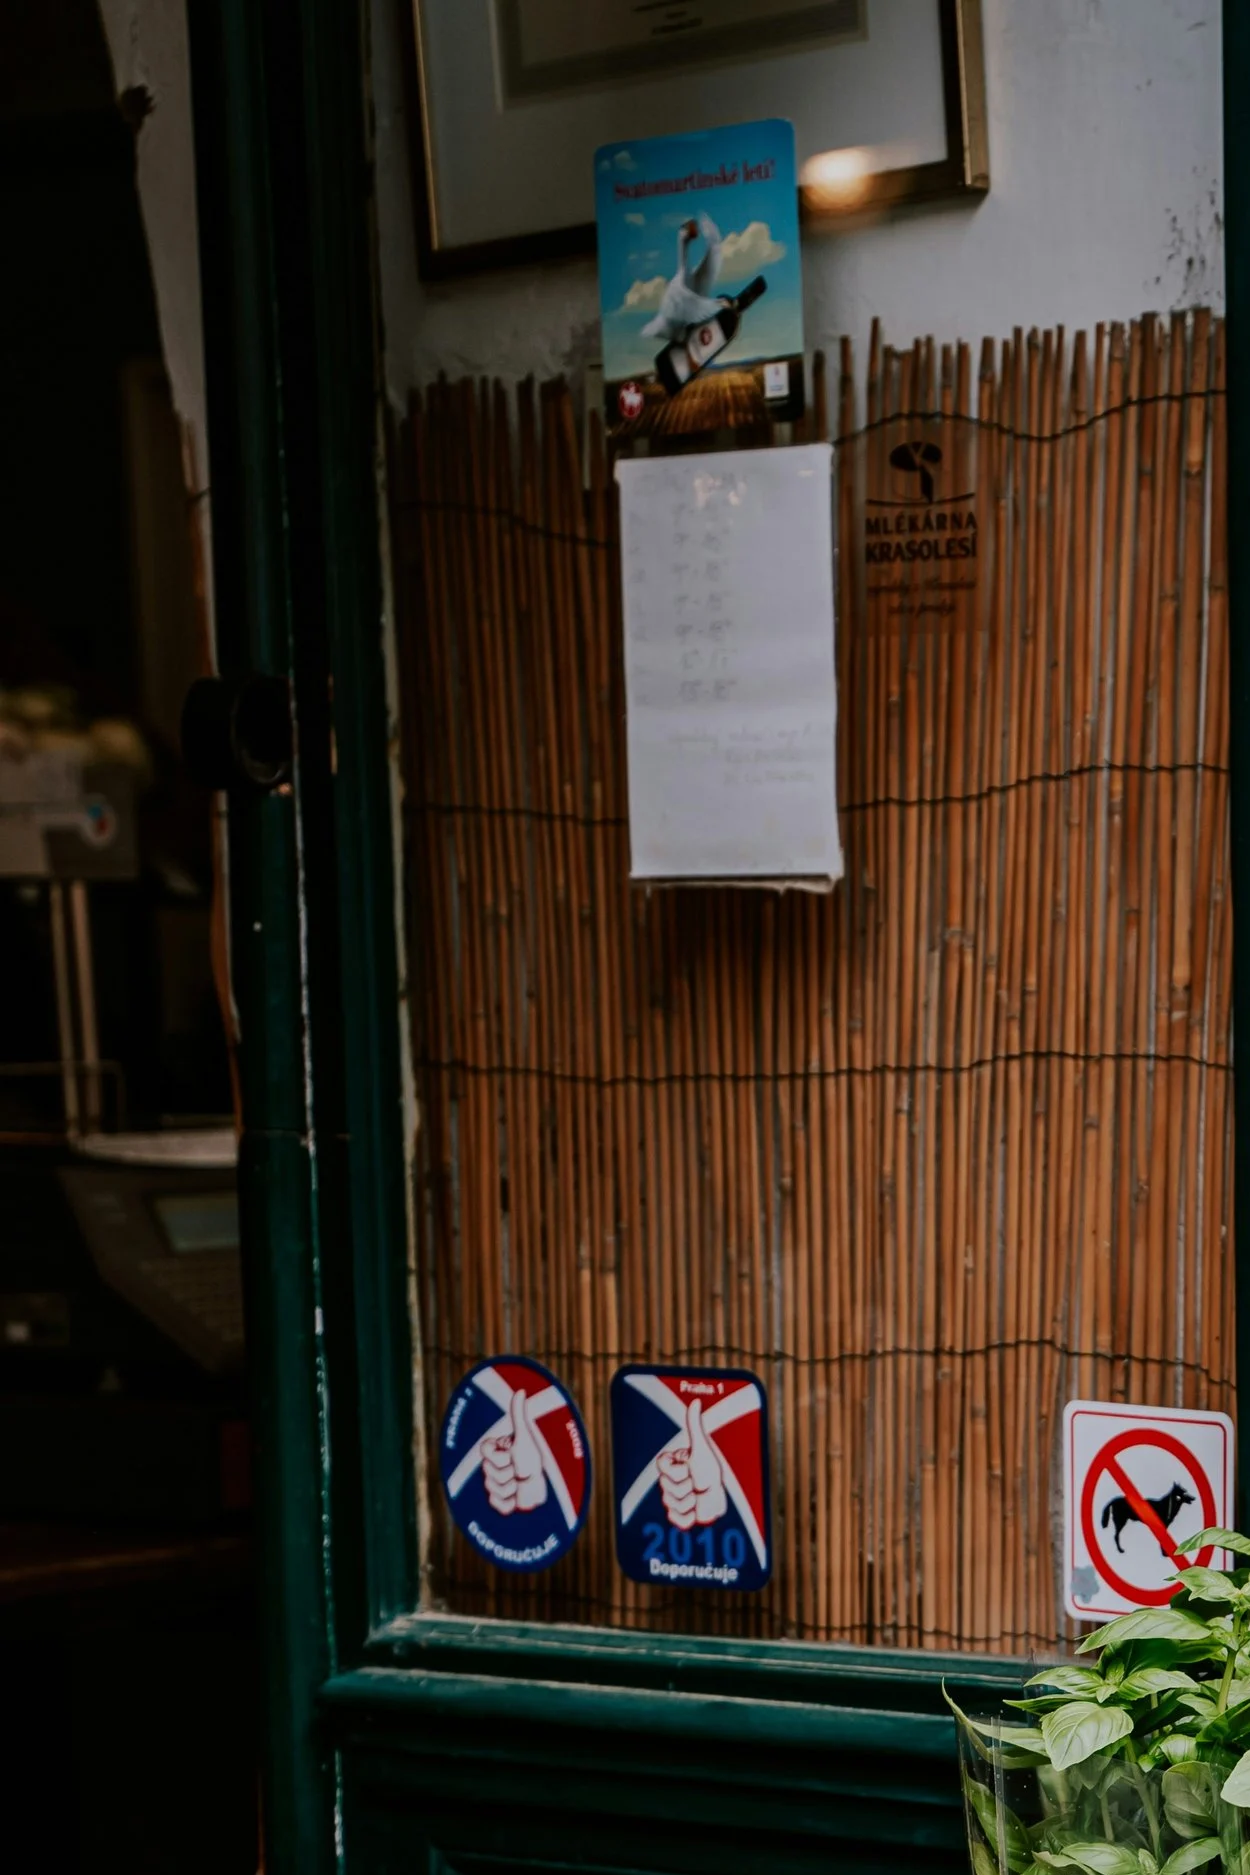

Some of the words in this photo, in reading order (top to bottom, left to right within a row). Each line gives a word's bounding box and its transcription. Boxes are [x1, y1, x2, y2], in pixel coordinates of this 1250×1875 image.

[865, 510, 978, 535] MLÉKÁRNA
[865, 531, 978, 563] KRASOLESÍ
[680, 1380, 715, 1396] Praha
[717, 1382, 725, 1395] 1
[467, 1520, 559, 1563] DOPORUČUJE
[642, 1521, 747, 1569] 2010
[649, 1557, 739, 1585] Doporučuje
